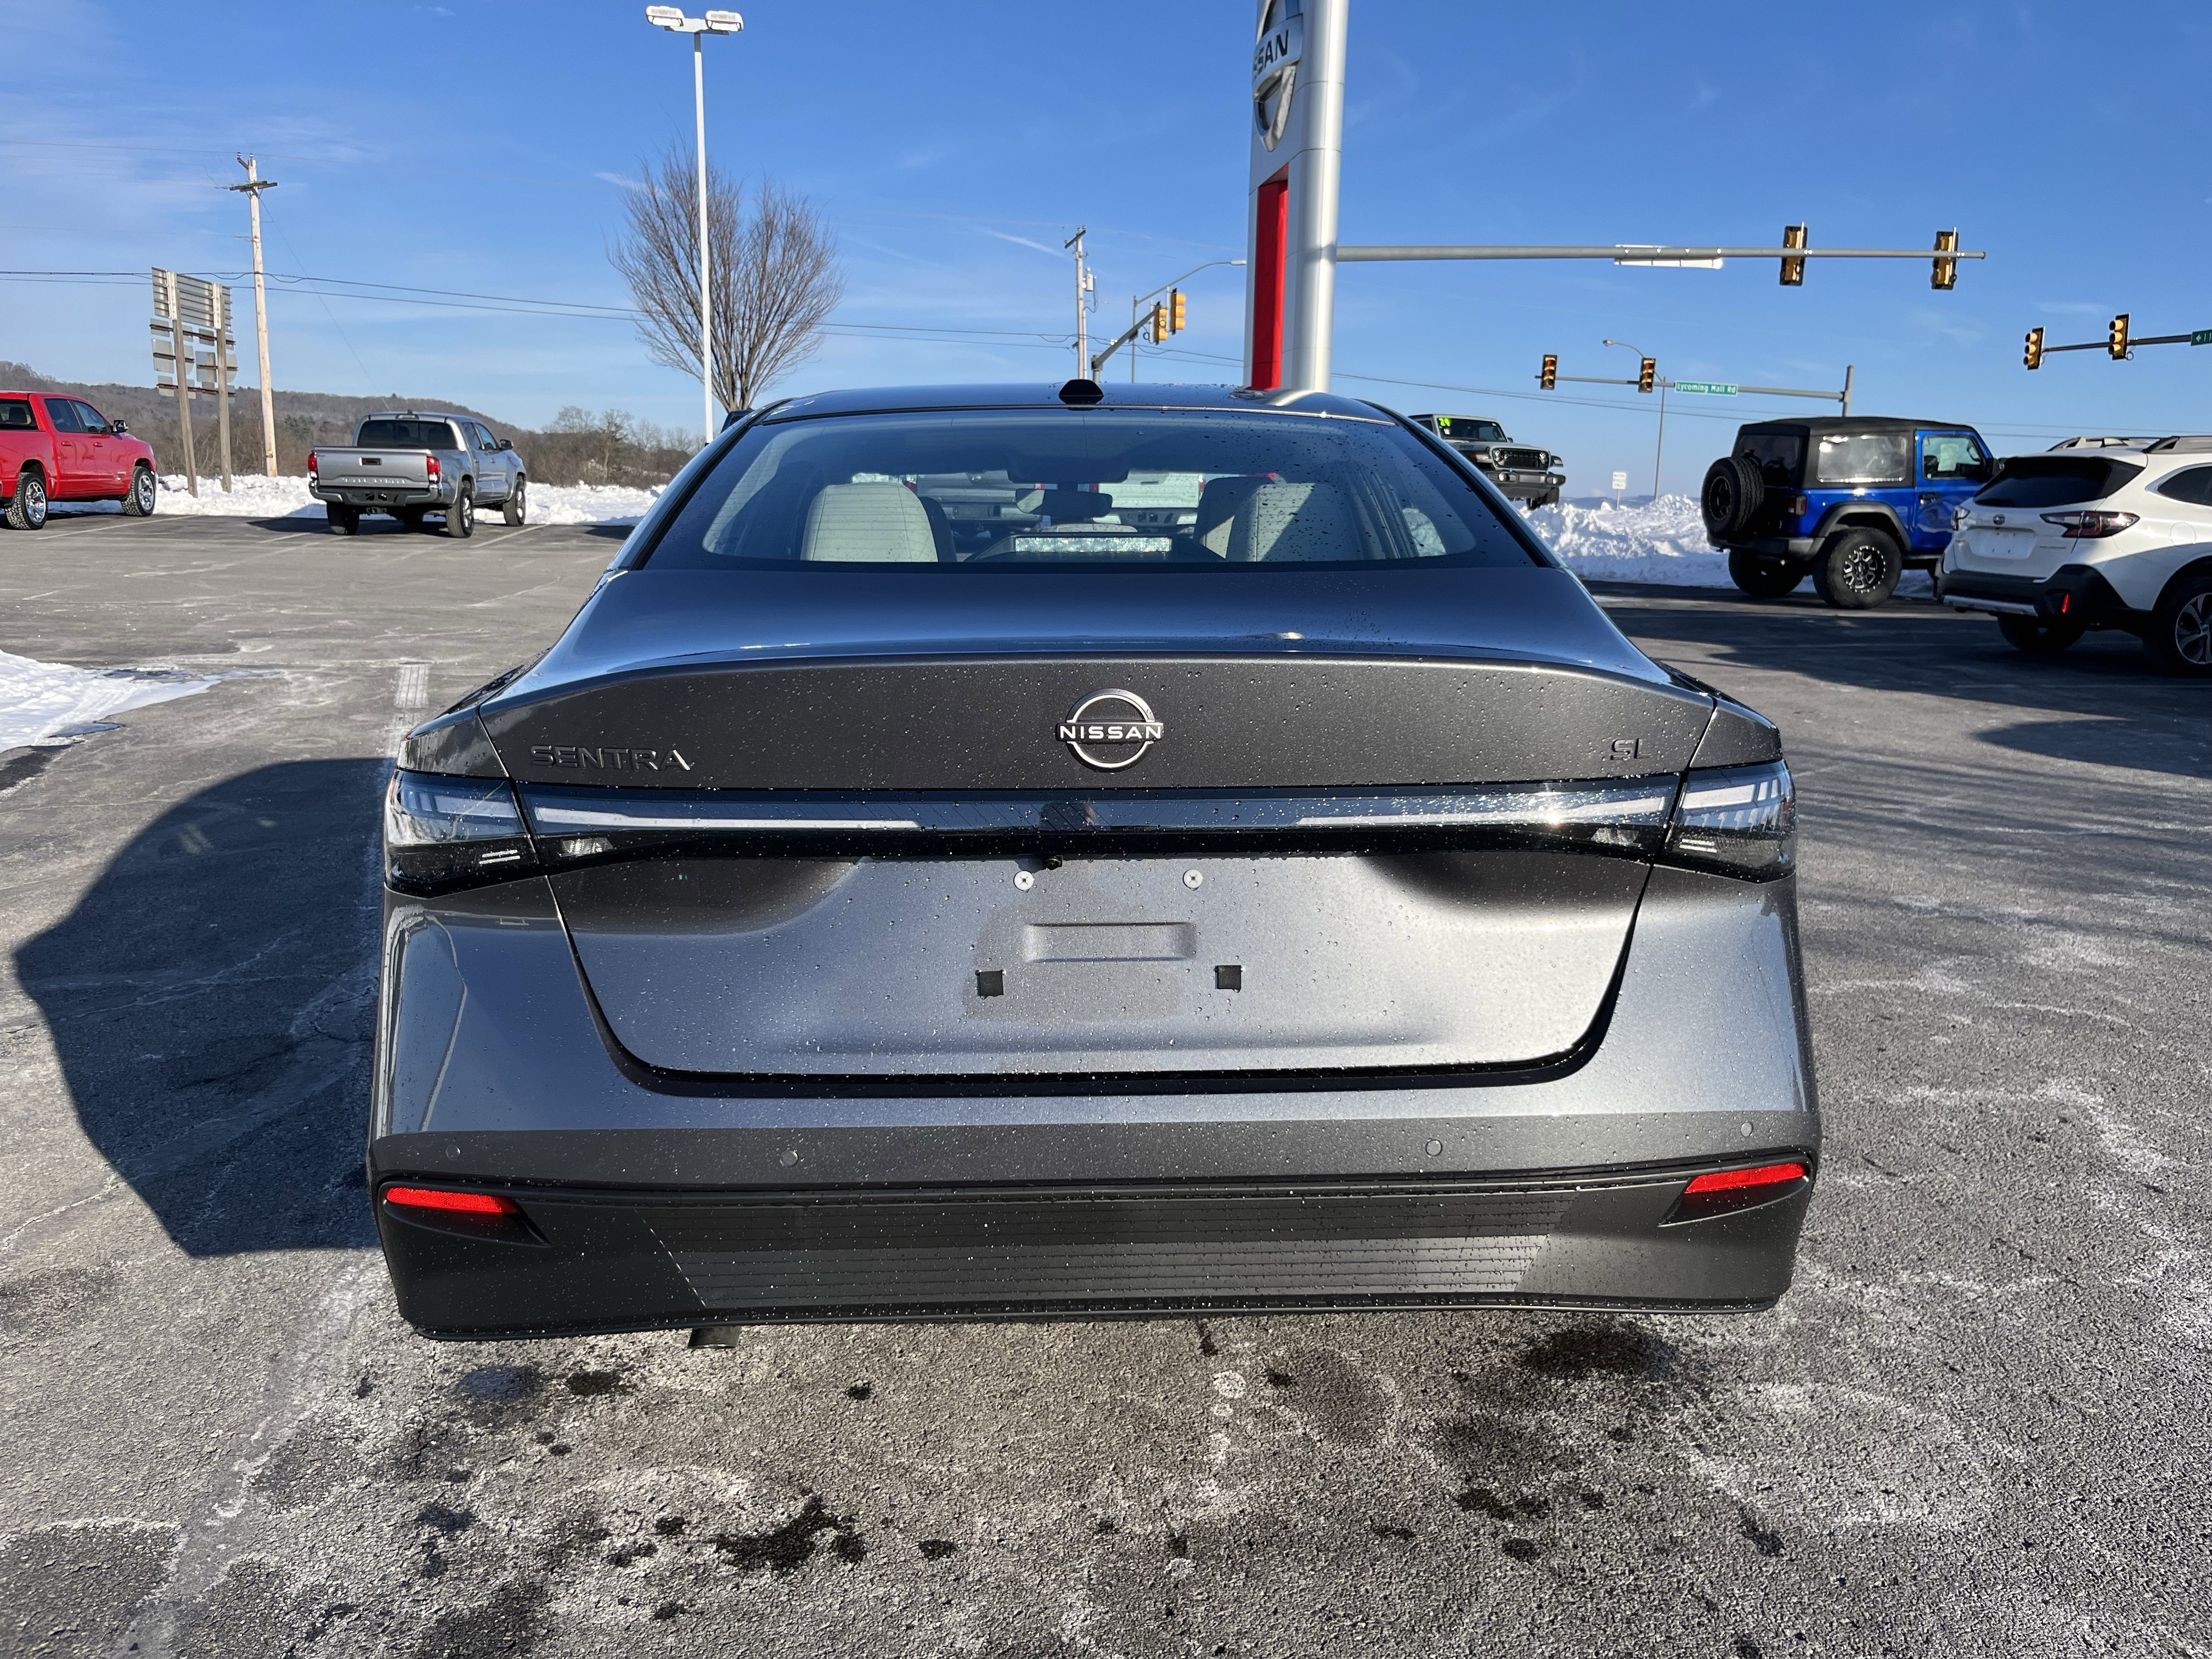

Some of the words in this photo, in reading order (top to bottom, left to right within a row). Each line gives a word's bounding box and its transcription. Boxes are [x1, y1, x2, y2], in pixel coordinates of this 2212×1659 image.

[1677, 383, 1708, 393] Lycoming
[1059, 725, 1161, 739] NISSAN
[531, 744, 691, 770] SENTRA
[1610, 738, 1653, 760] SL
